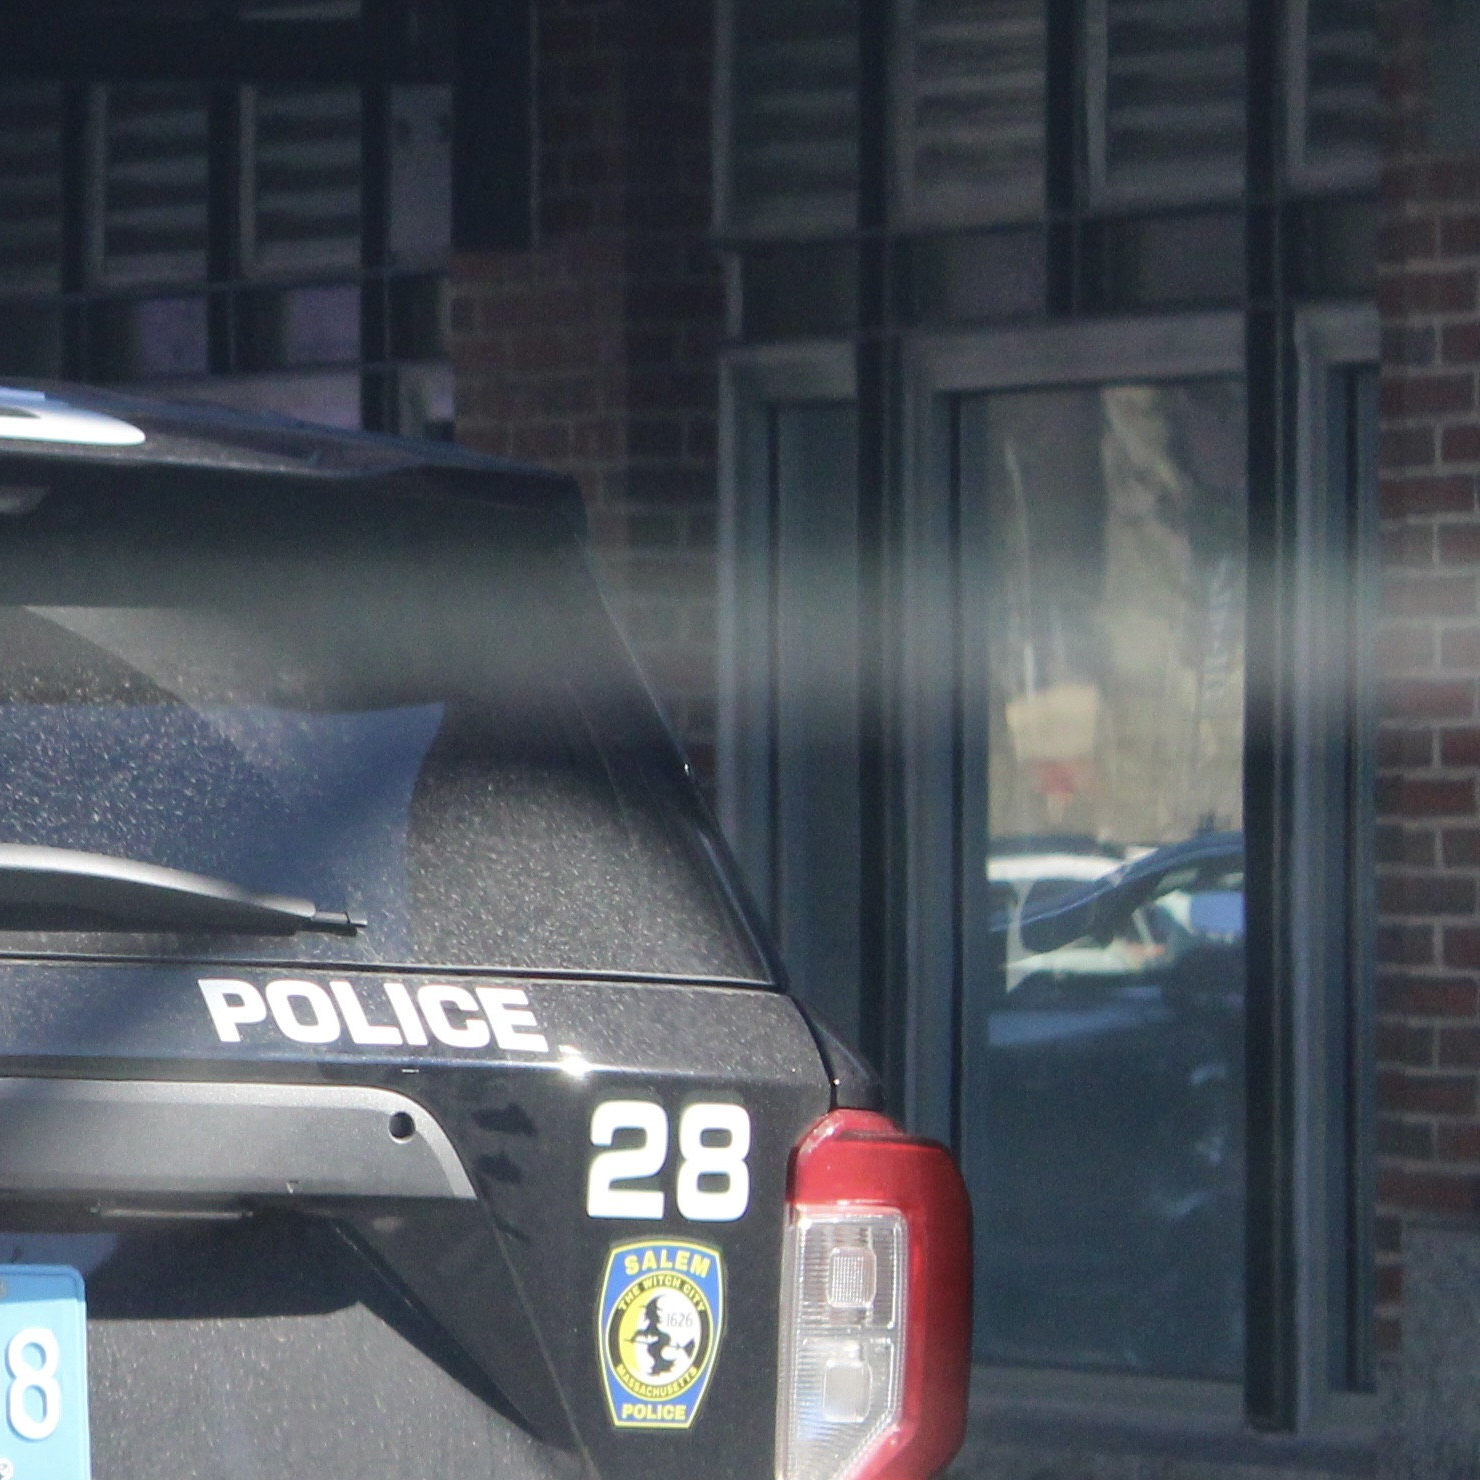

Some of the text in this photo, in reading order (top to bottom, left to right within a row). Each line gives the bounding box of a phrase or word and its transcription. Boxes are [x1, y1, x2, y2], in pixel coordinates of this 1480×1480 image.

[198, 979, 549, 1053] POLICE
[587, 1100, 751, 1221] 28
[624, 1249, 711, 1278] SALEM
[618, 1275, 705, 1311] THE WITCH CITY
[666, 1312, 694, 1328] 1626
[615, 1364, 699, 1399] MASSACHUSETTS
[622, 1403, 687, 1421] POLICE
